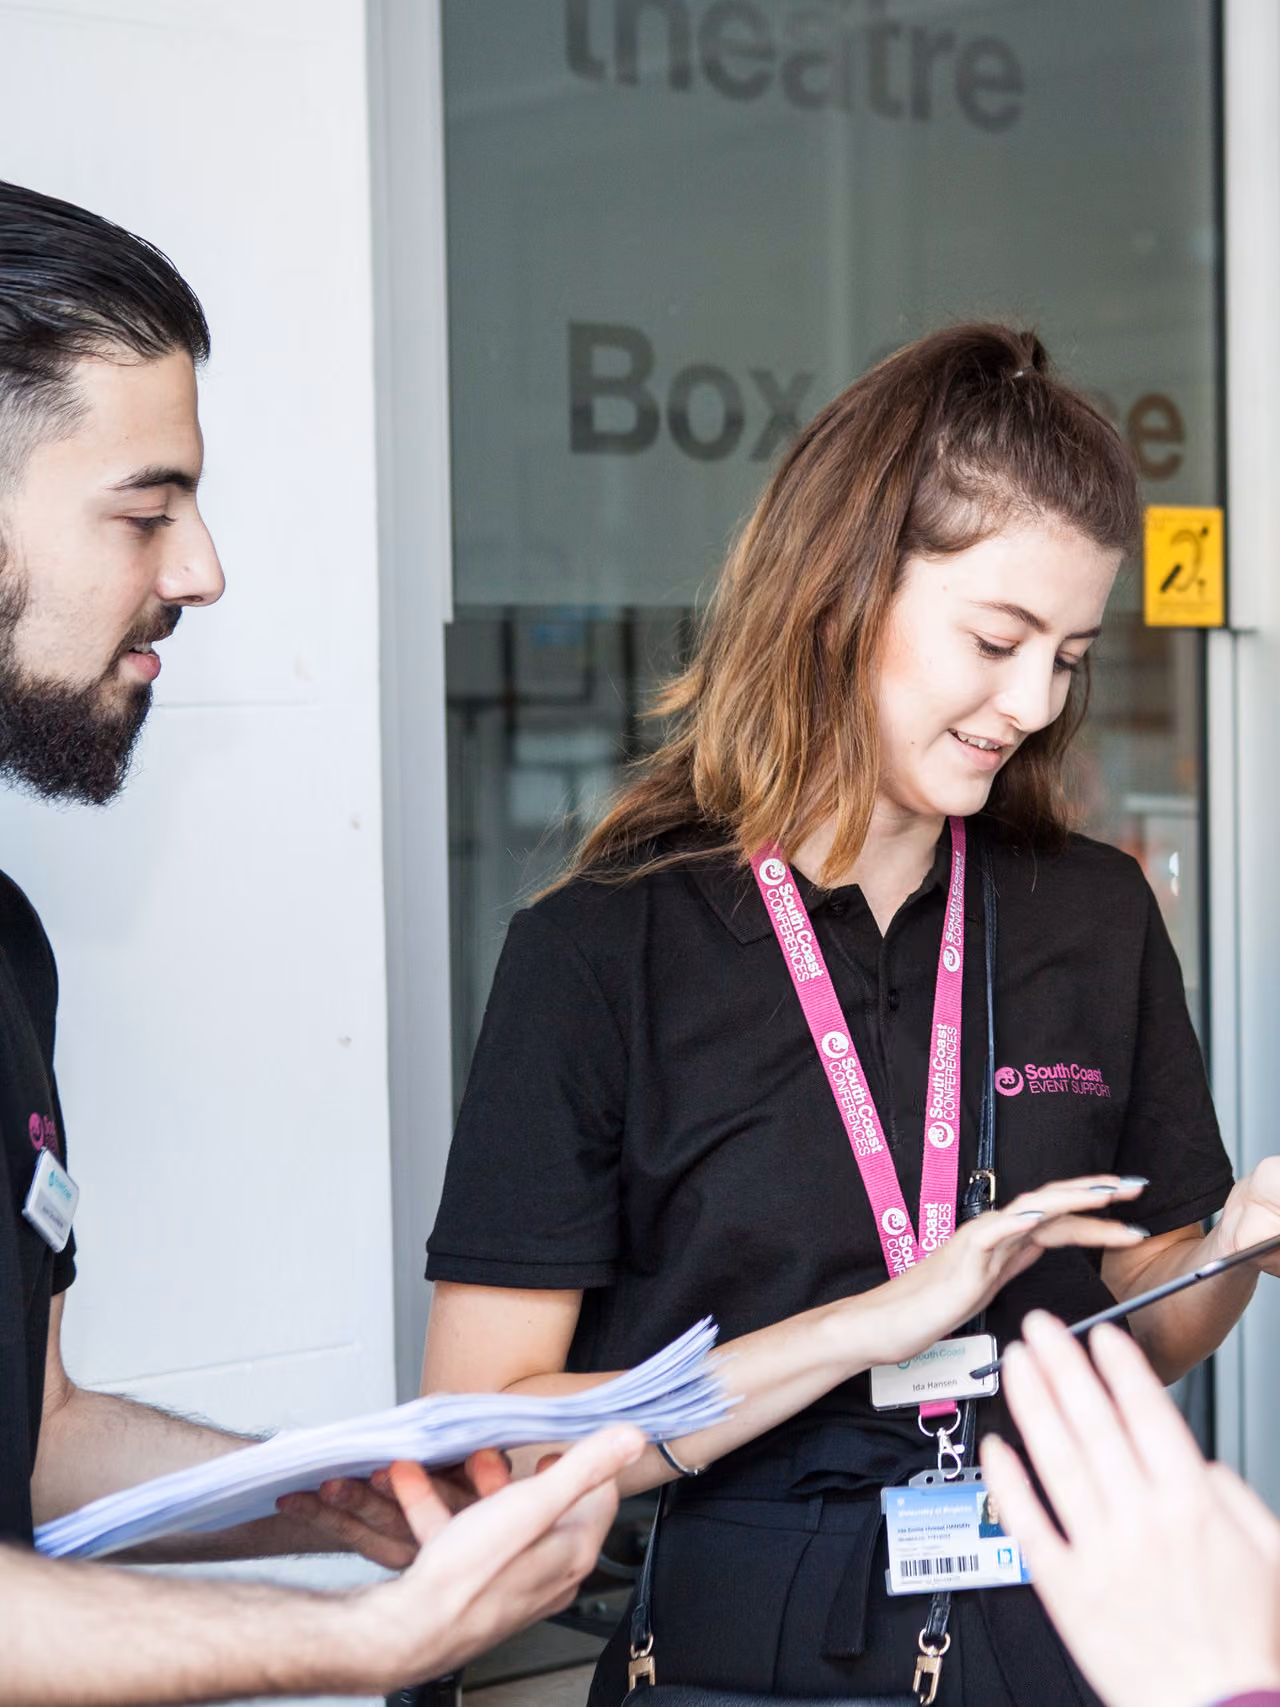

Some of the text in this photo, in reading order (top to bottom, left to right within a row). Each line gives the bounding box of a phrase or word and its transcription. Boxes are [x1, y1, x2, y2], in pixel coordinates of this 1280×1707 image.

[567, 320, 817, 462] Box
[767, 888, 810, 982] CONFERENCES
[779, 883, 824, 978] South Coast
[829, 1062, 870, 1156] CONFERENCES
[842, 1057, 884, 1154] South Coast
[929, 1023, 947, 1119] South Coast
[943, 1026, 958, 1120] CONFERENCES
[1024, 1063, 1103, 1083] South Coast
[1029, 1080, 1112, 1098] EVENT SUPPORT
[899, 1235, 916, 1268] Sou
[922, 1203, 939, 1251] Coast
[912, 1378, 958, 1392] Ida Hansen
